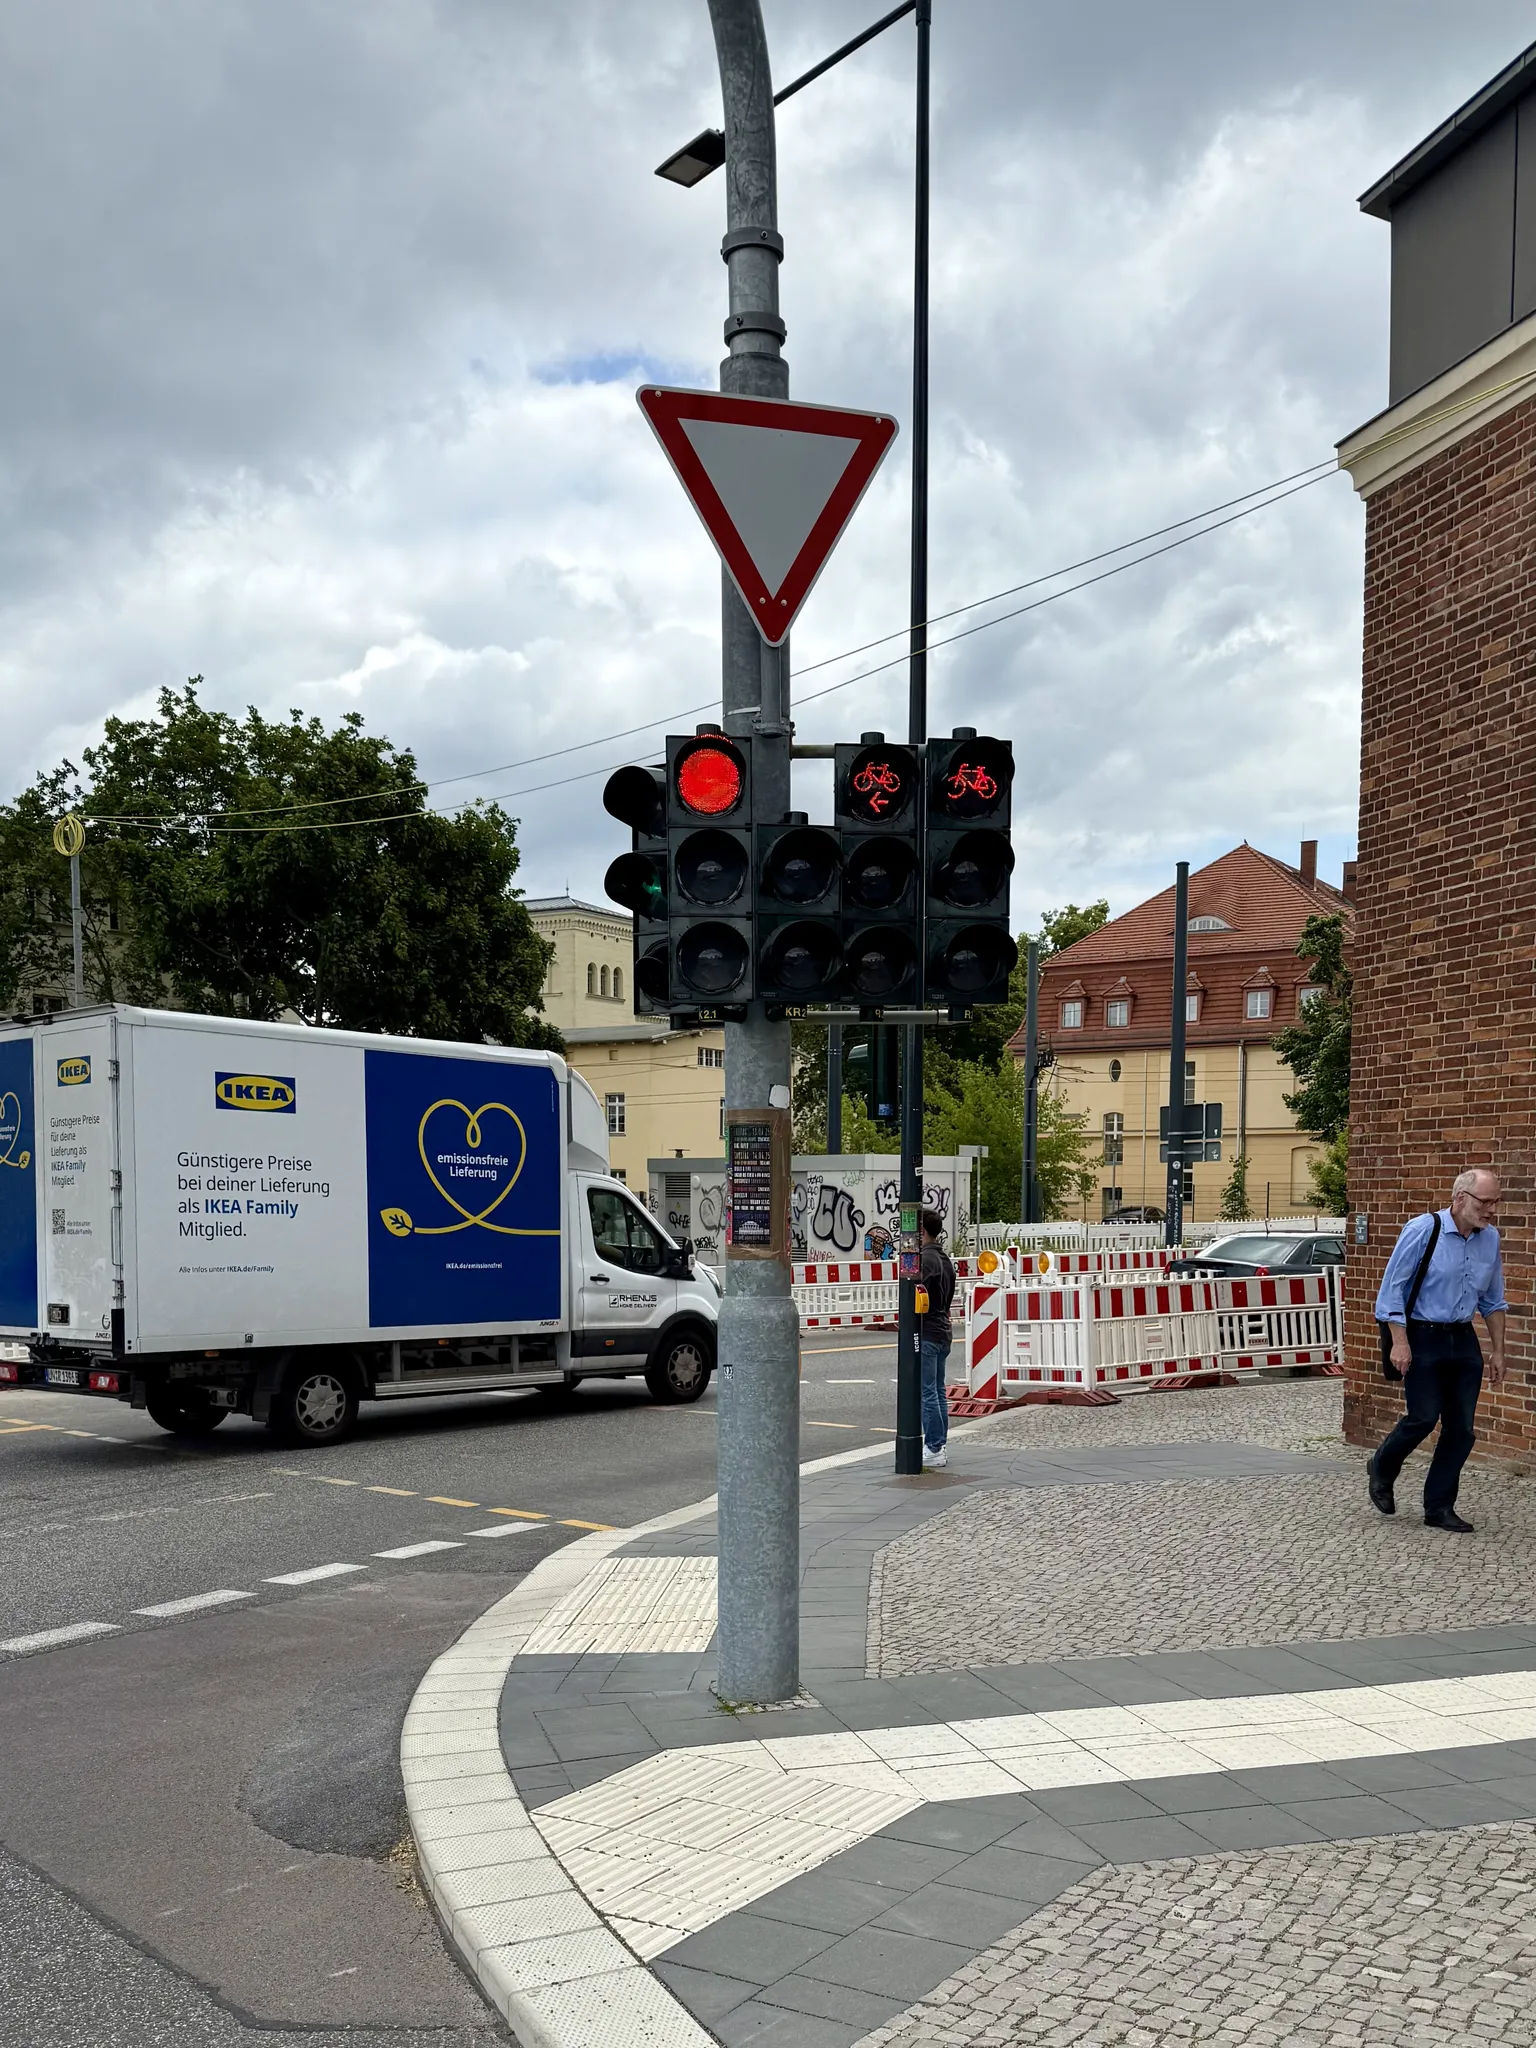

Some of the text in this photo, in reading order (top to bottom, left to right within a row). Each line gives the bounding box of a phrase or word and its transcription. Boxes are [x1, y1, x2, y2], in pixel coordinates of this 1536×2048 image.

[60, 1064, 88, 1078] IKEA
[223, 1083, 290, 1102] IKEA
[50, 1114, 100, 1129] Günstigere Preise
[51, 1131, 76, 1142] für deine
[51, 1145, 87, 1158] Lieferung als
[51, 1159, 86, 1173] IKEA Family
[177, 1152, 312, 1172] Günstigere Preise
[437, 1153, 509, 1166] emissionsfreie
[450, 1166, 498, 1181] Lieferung
[178, 1174, 330, 1197] bei deiner Lieferung
[178, 1197, 299, 1218] als IKEA Family
[179, 1221, 247, 1241] Mitglied.
[226, 1265, 275, 1274] IKEA.de/Family
[445, 1262, 503, 1270] IKEA.de/emissionsfrei
[619, 1294, 657, 1302] RHENUS
